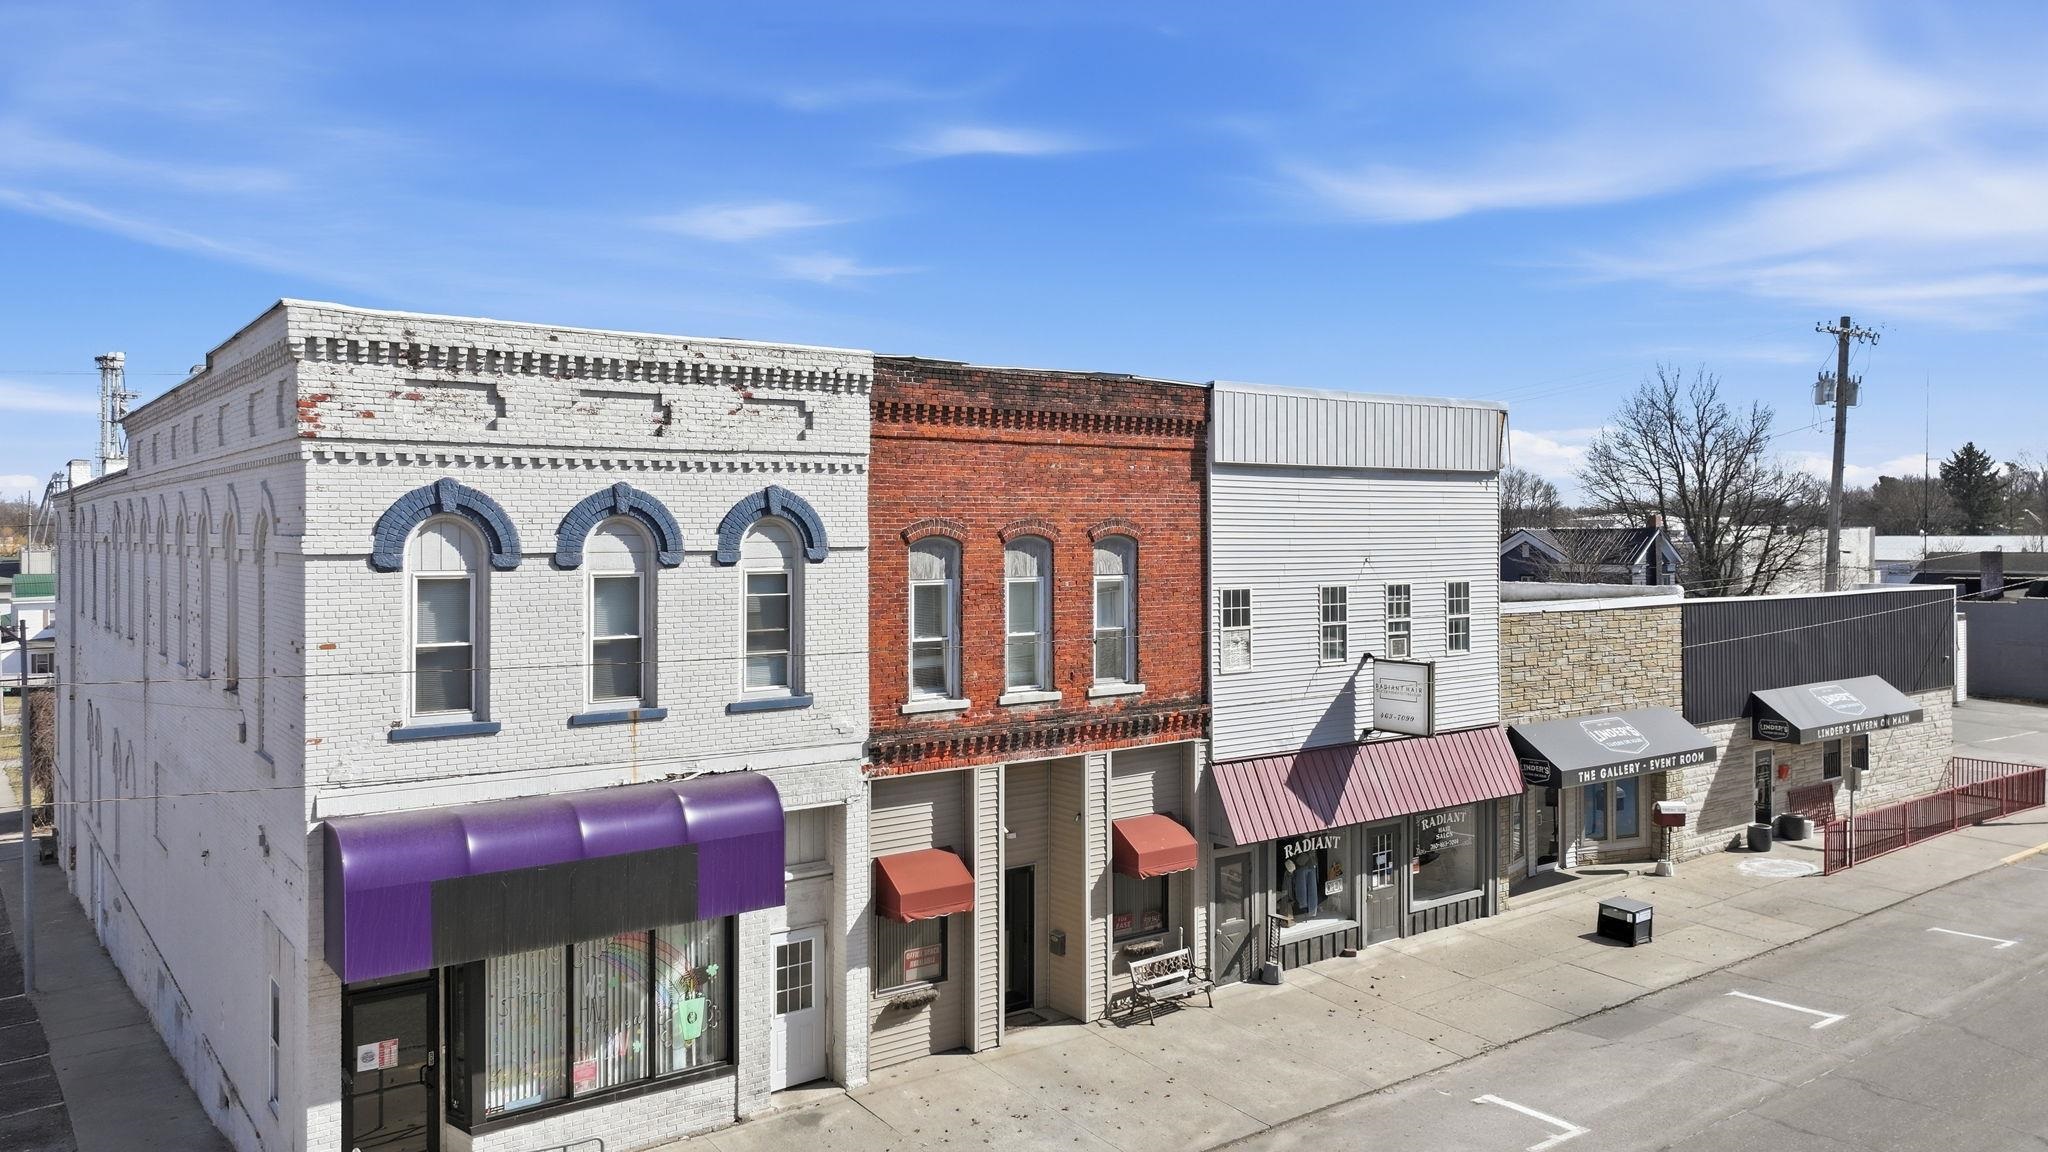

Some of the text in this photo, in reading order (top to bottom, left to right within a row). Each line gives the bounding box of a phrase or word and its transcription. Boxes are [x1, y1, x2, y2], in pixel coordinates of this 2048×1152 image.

[1375, 683, 1404, 691] RADIANT
[1406, 686, 1423, 694] HAIR
[1588, 725, 1640, 743] LINDER'S
[1817, 724, 1851, 738] LINDER'S
[1853, 719, 1878, 732] TAVERN
[1892, 714, 1910, 726] MAIN
[1578, 770, 1596, 783] THE
[1600, 762, 1641, 779] GALLERY
[1649, 756, 1677, 770] EVENT
[1679, 752, 1705, 765] ROOM
[1421, 811, 1467, 831] RADIANT
[1284, 836, 1341, 859] RADIANT
[583, 974, 606, 999] WE
